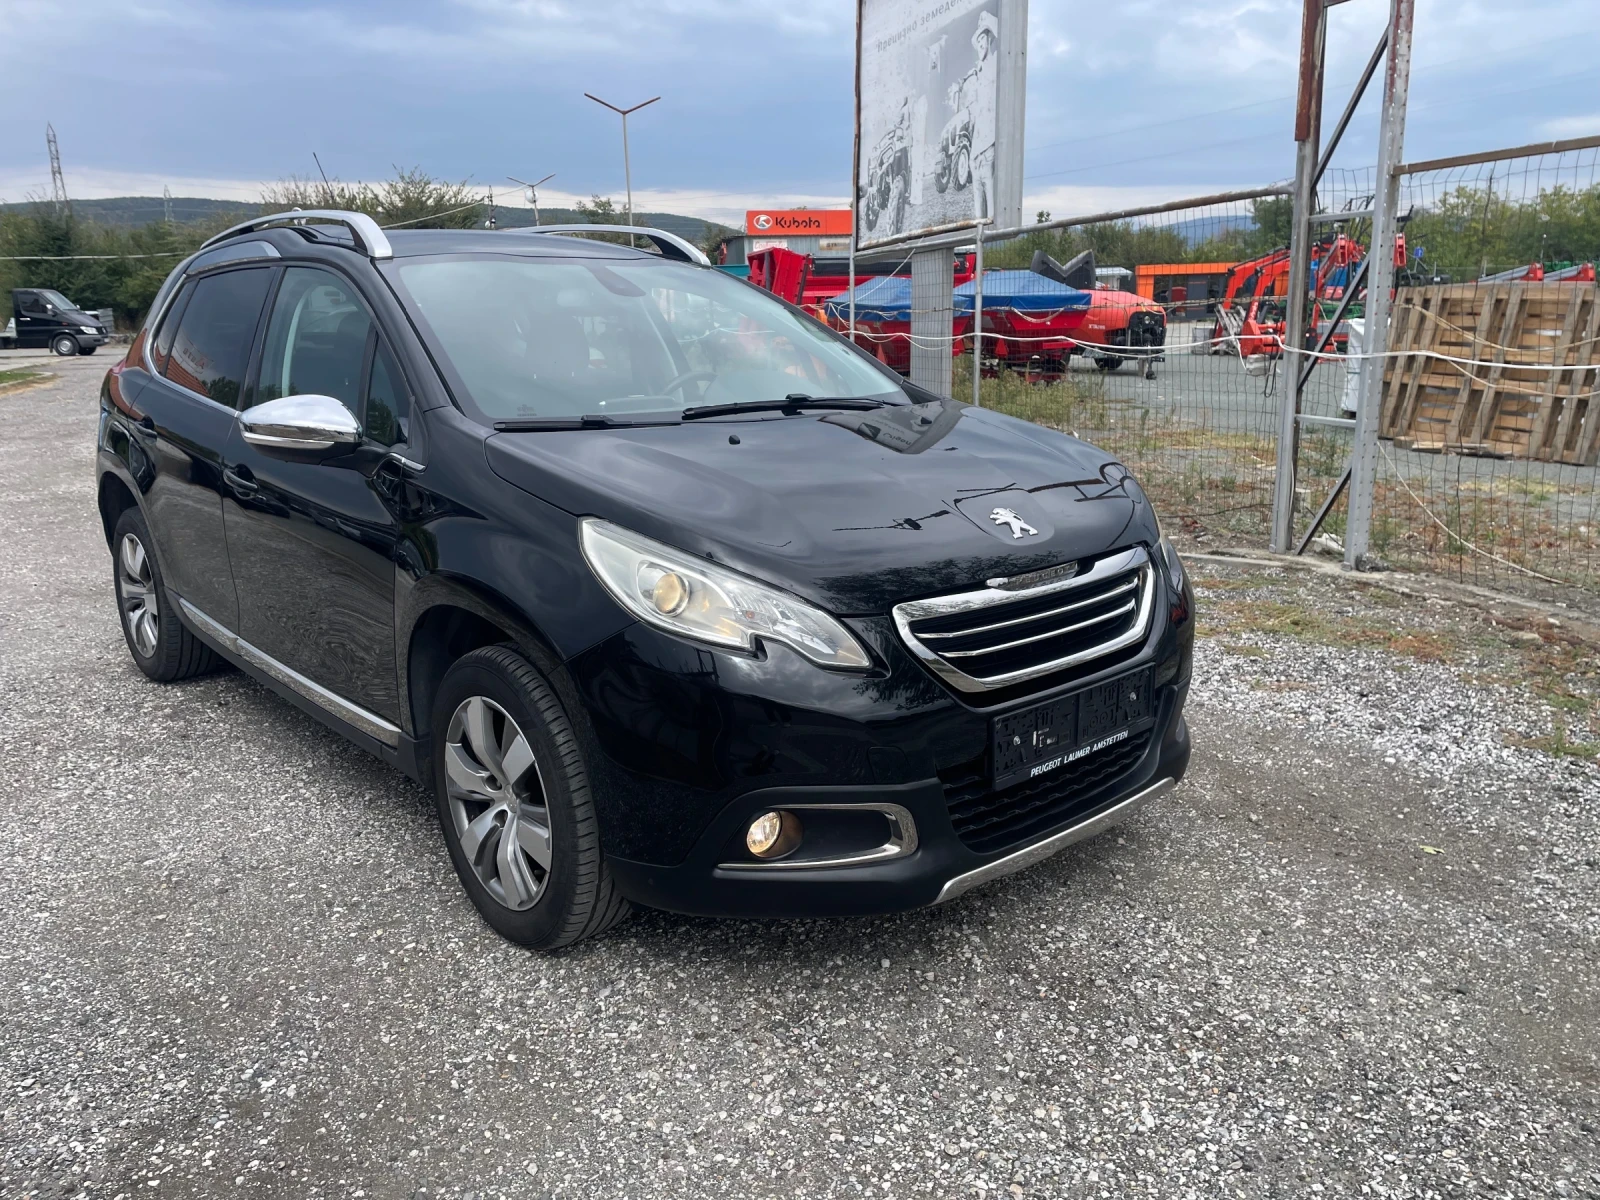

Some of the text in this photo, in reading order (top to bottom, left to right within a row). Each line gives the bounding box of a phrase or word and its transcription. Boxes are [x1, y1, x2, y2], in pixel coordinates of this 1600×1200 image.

[775, 216, 821, 228] Kubota
[1030, 729, 1129, 778] PEUGEOT LAUMER AMSTETTEN
